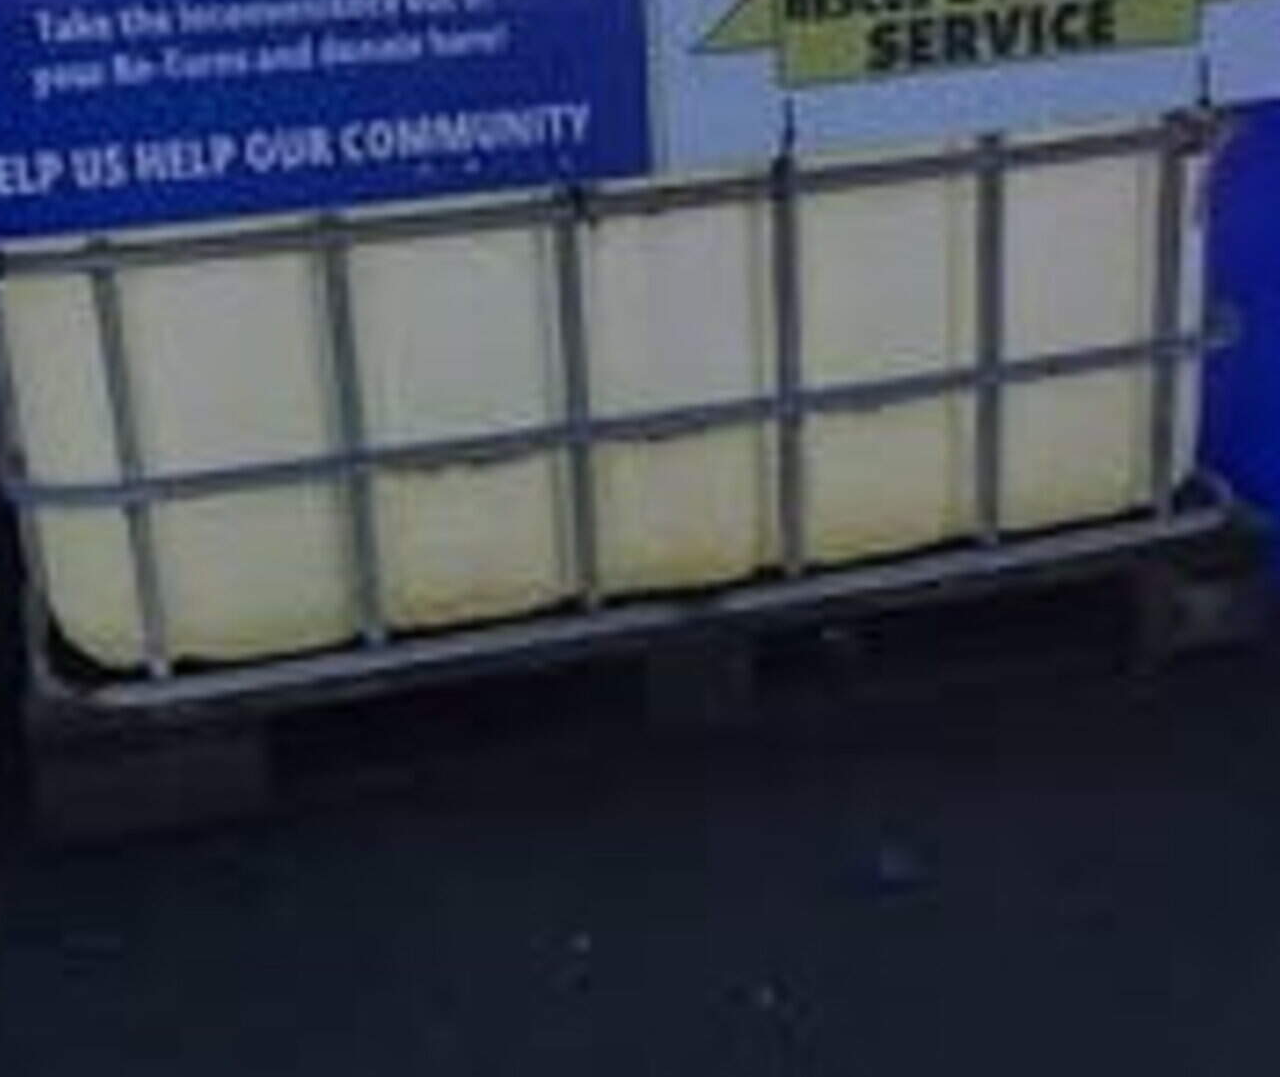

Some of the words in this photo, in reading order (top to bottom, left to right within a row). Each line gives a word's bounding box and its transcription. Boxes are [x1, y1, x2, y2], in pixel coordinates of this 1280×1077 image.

[33, 8, 112, 44] Take
[118, 0, 170, 37] the
[30, 61, 105, 101] your
[257, 30, 313, 72] and
[318, 29, 421, 69] donate
[70, 141, 128, 190] US
[132, 133, 238, 182] HELP
[244, 125, 335, 173] OUR
[339, 102, 591, 163] COMMUNITY
